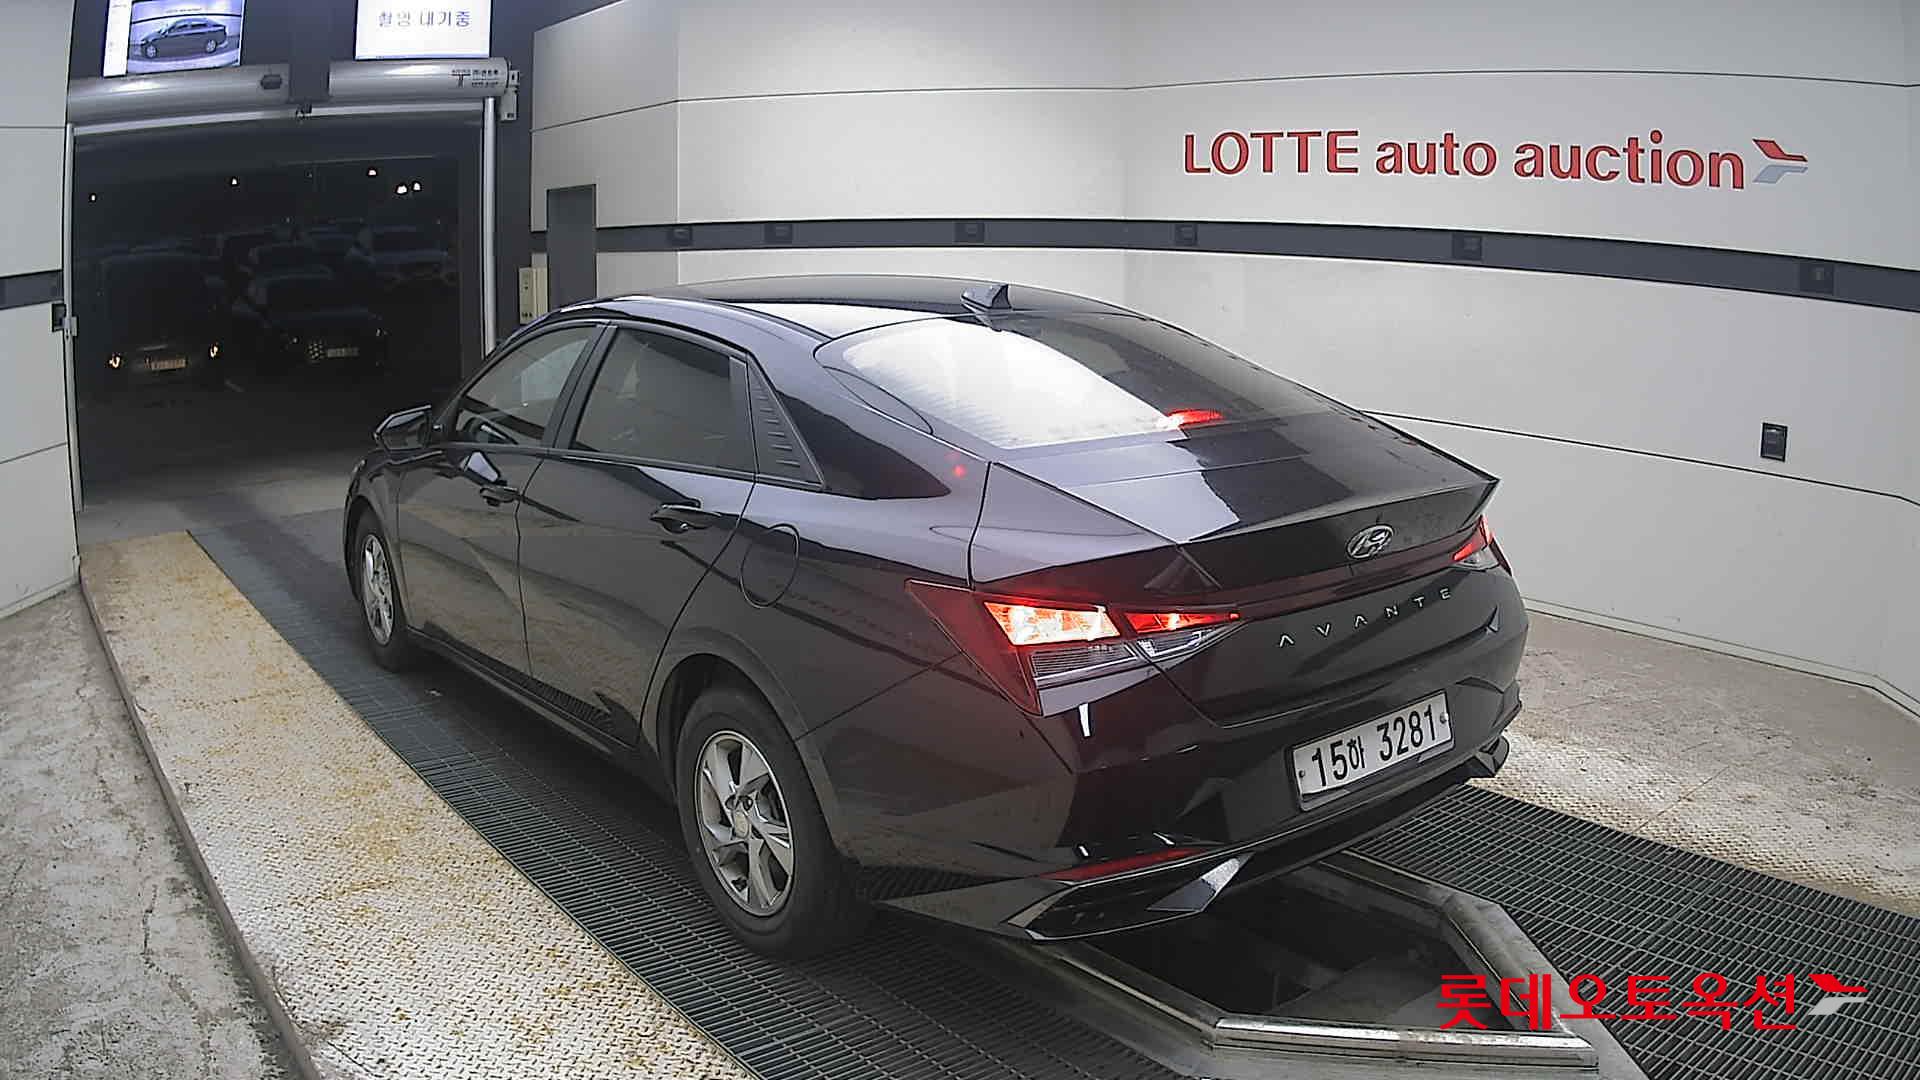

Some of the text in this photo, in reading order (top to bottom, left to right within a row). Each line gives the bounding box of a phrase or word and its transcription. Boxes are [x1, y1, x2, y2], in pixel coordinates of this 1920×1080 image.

[419, 10, 471, 27] 대기중
[1184, 130, 1745, 189] LOTTE auto auction
[1278, 588, 1452, 648] AVANTE
[1311, 704, 1436, 787] 15하 3281
